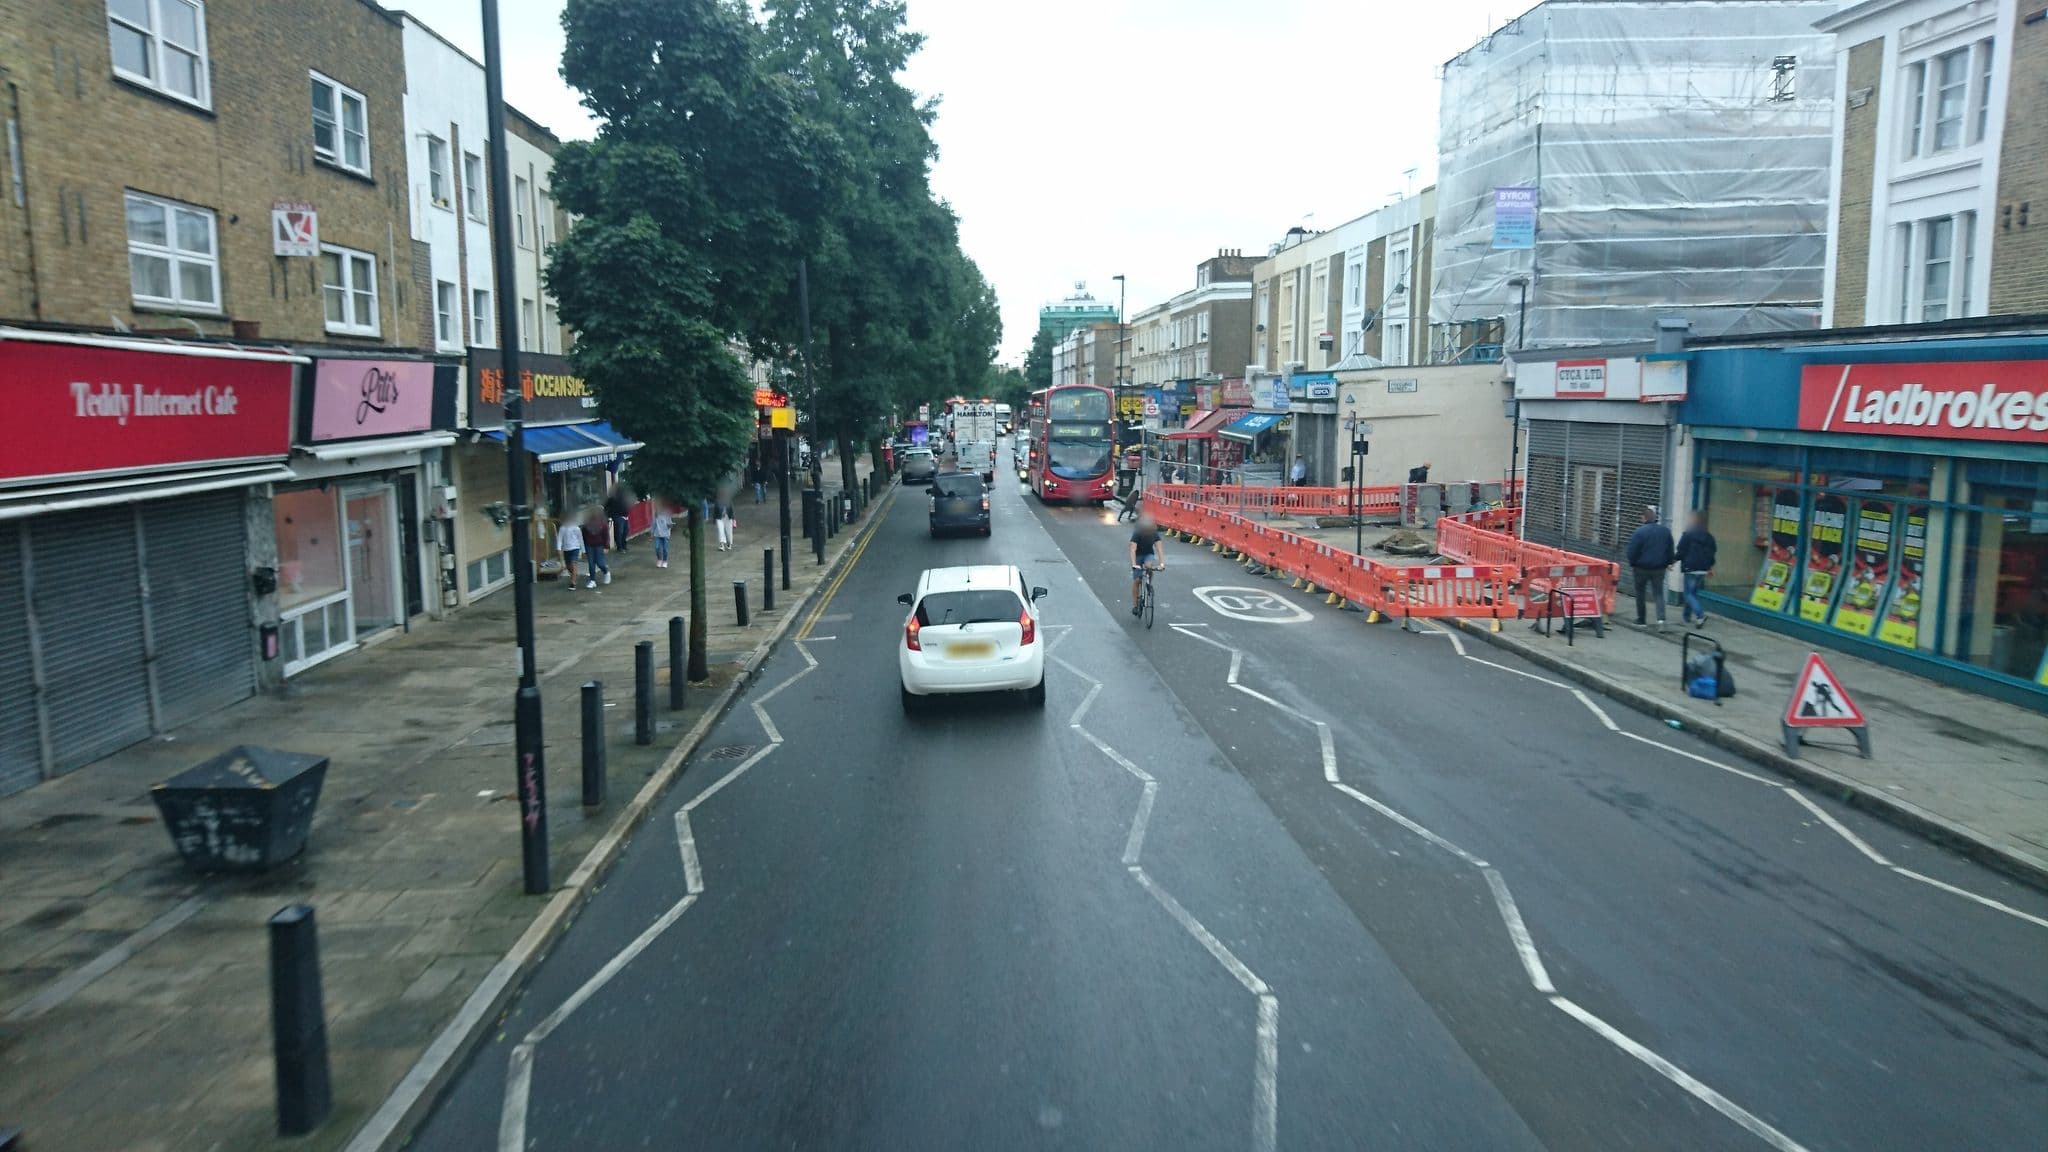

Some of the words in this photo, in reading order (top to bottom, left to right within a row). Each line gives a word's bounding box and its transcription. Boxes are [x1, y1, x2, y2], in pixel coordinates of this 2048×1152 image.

[1500, 191, 1530, 201] BYRON
[534, 373, 567, 397] OCEAN
[69, 382, 129, 426] Teddy
[133, 383, 202, 416] Internet
[1843, 383, 2048, 431] Ladbrokes
